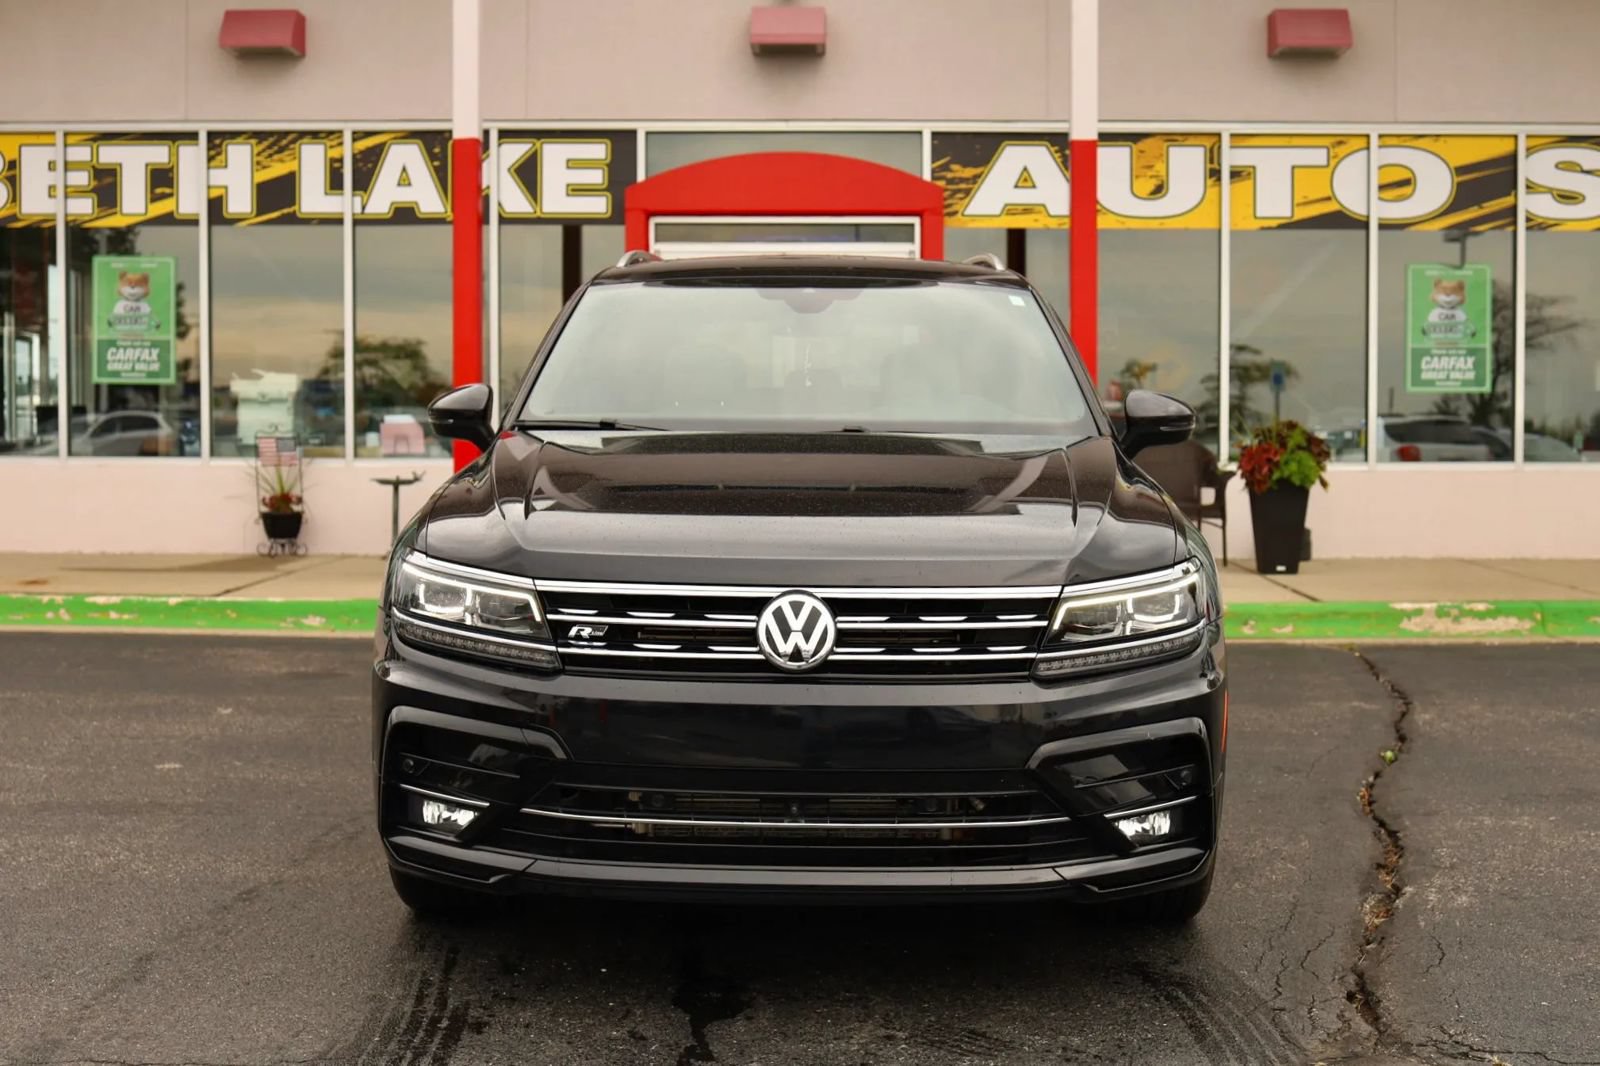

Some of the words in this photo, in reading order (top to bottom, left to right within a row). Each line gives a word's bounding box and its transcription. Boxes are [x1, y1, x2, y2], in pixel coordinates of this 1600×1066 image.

[0, 142, 256, 218] ETH
[296, 139, 612, 218] LAKE
[960, 141, 1457, 223] AUTO
[107, 347, 161, 362] CARFAX
[1421, 355, 1475, 370] CARFAX
